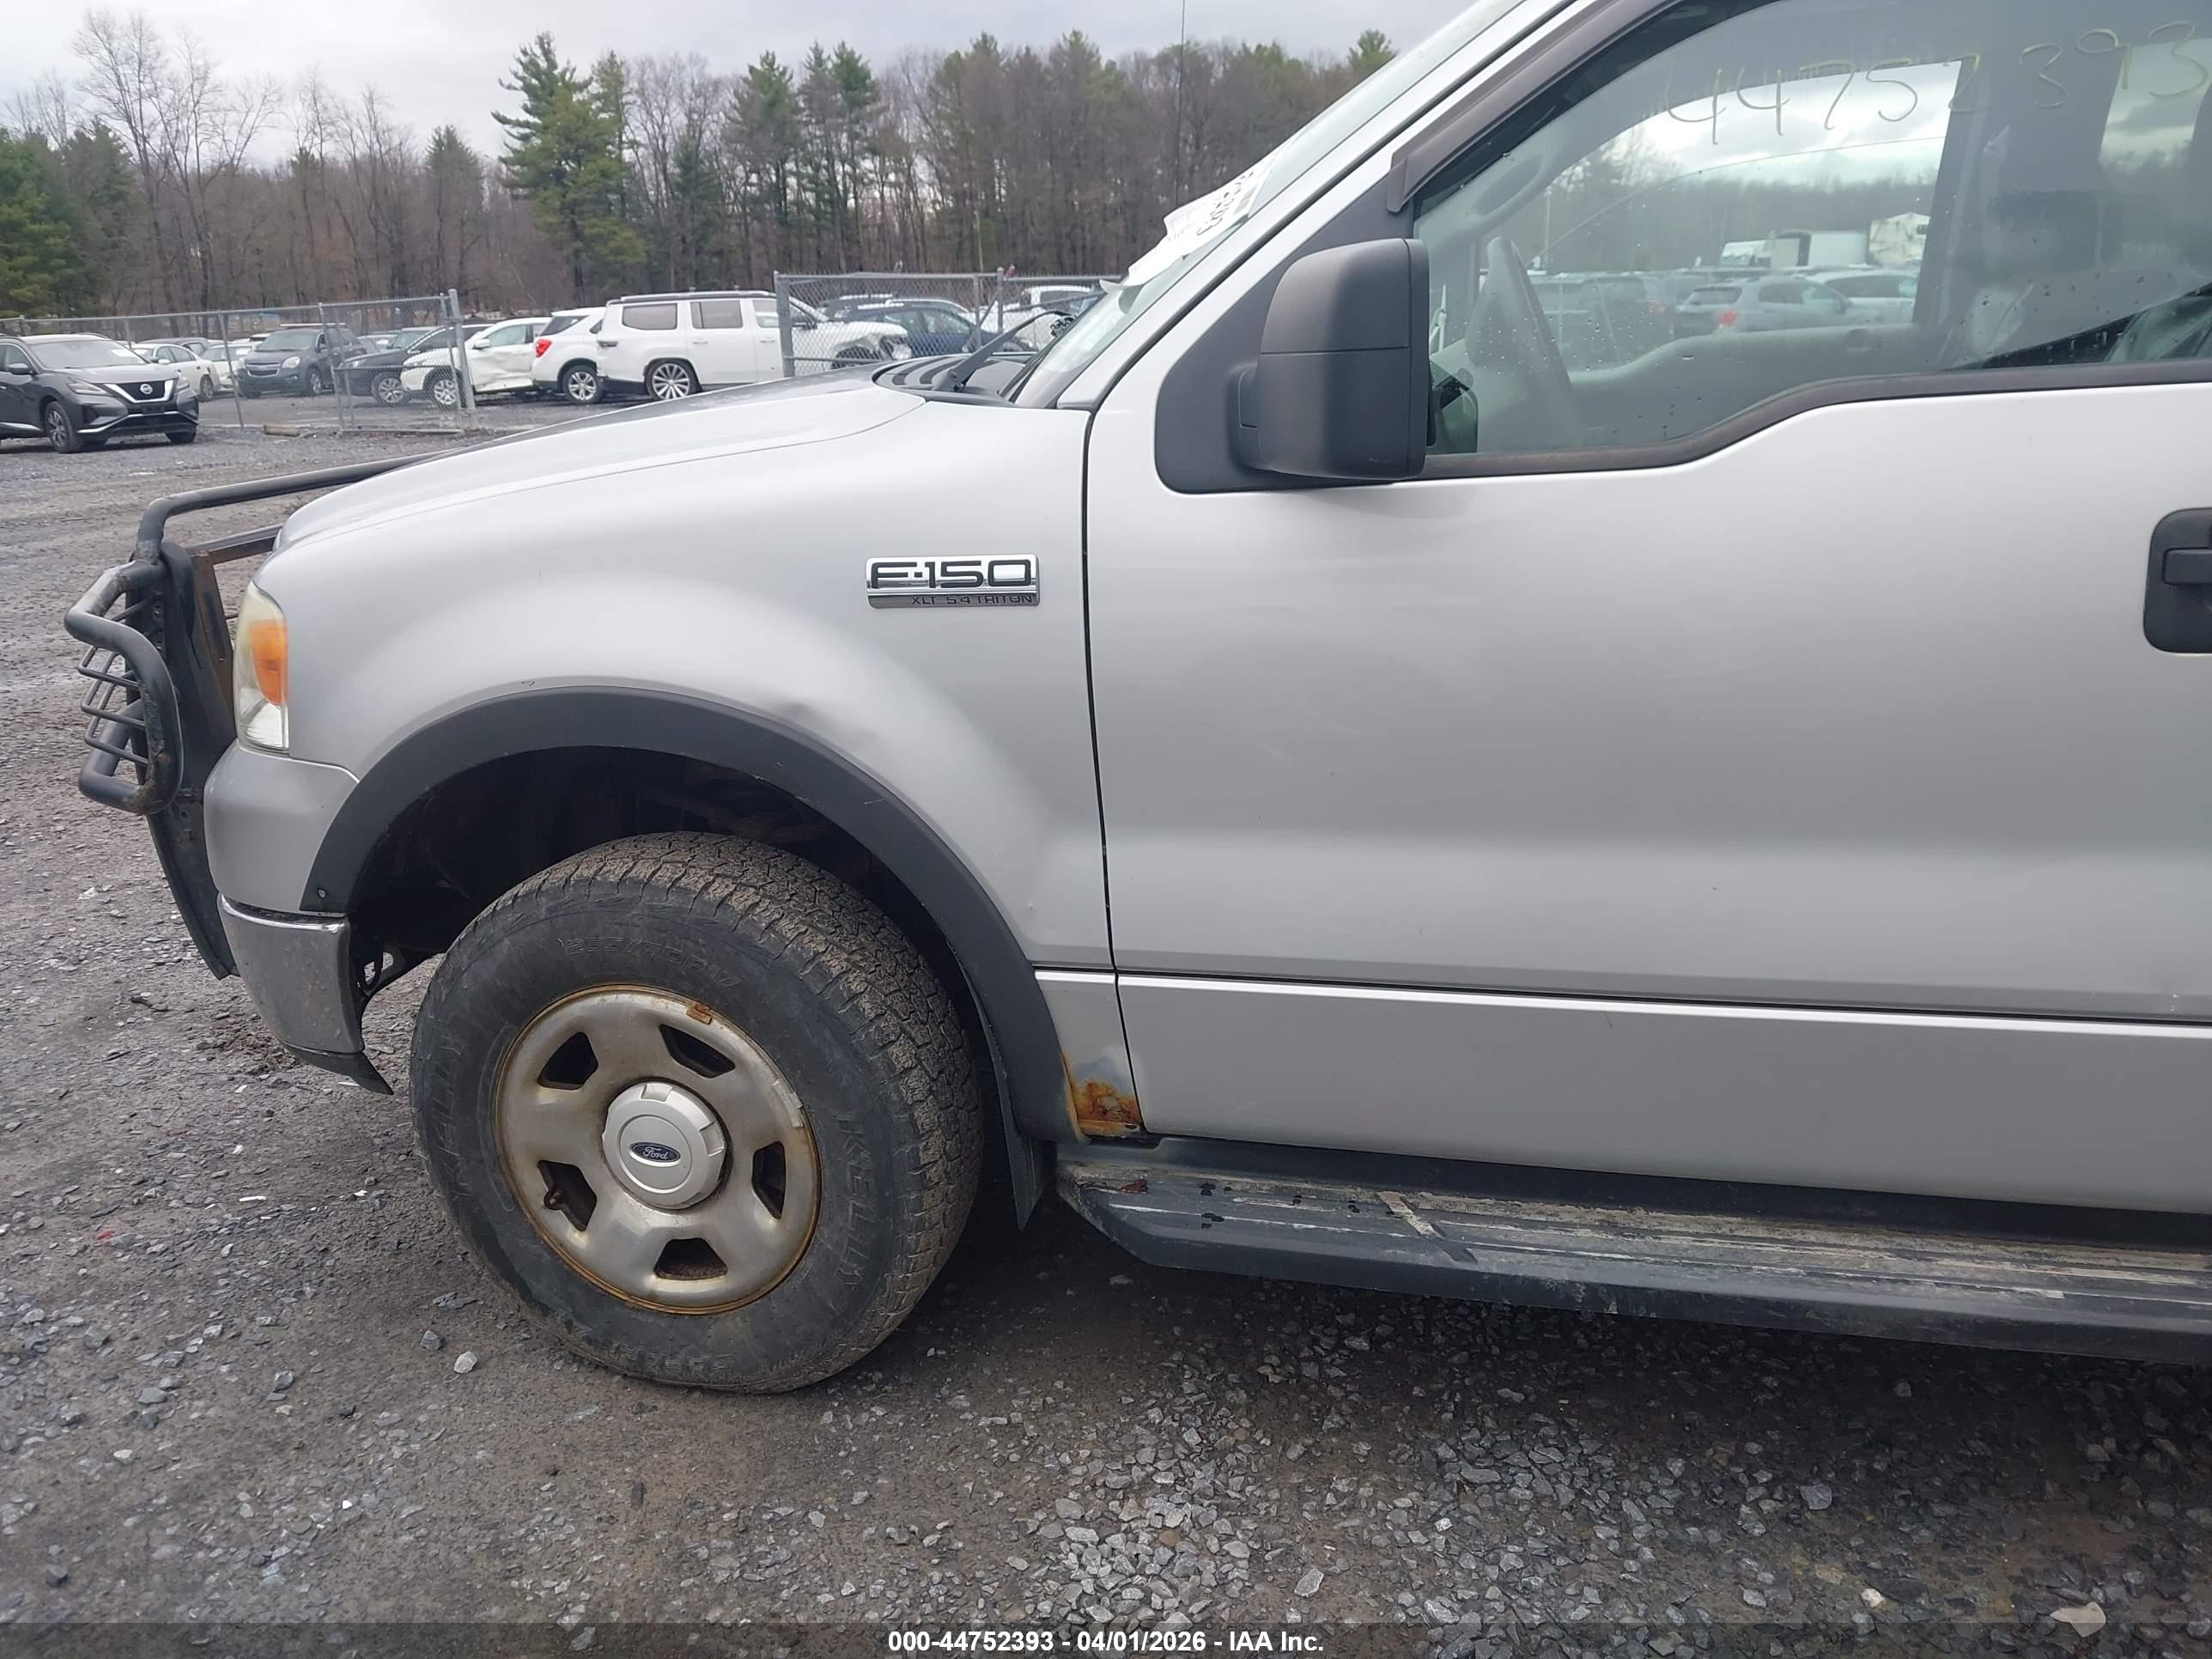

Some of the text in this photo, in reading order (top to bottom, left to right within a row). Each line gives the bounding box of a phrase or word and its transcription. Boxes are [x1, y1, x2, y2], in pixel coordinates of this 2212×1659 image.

[911, 593, 1033, 605] XLT 5.4 TRITON
[643, 1146, 669, 1160] Ford
[833, 1115, 877, 1287] KELLY
